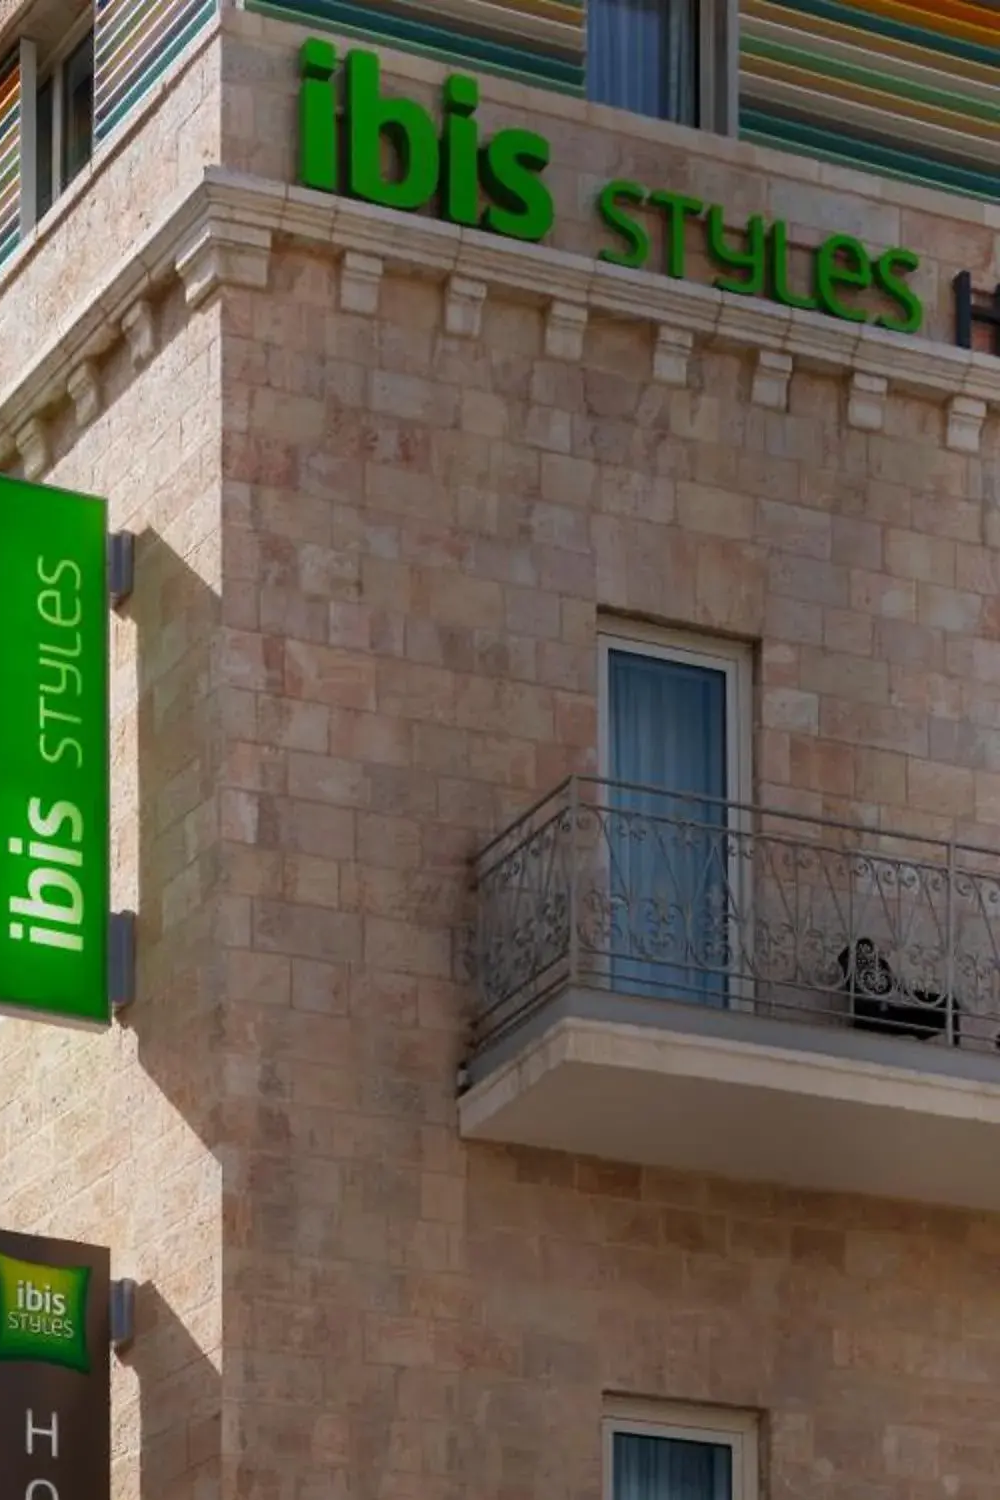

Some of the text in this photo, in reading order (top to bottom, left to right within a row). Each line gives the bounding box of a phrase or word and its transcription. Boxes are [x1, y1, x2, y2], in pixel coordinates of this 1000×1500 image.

[300, 37, 554, 242] ibis
[8, 797, 83, 951] ibis
[17, 1280, 66, 1316] ibis
